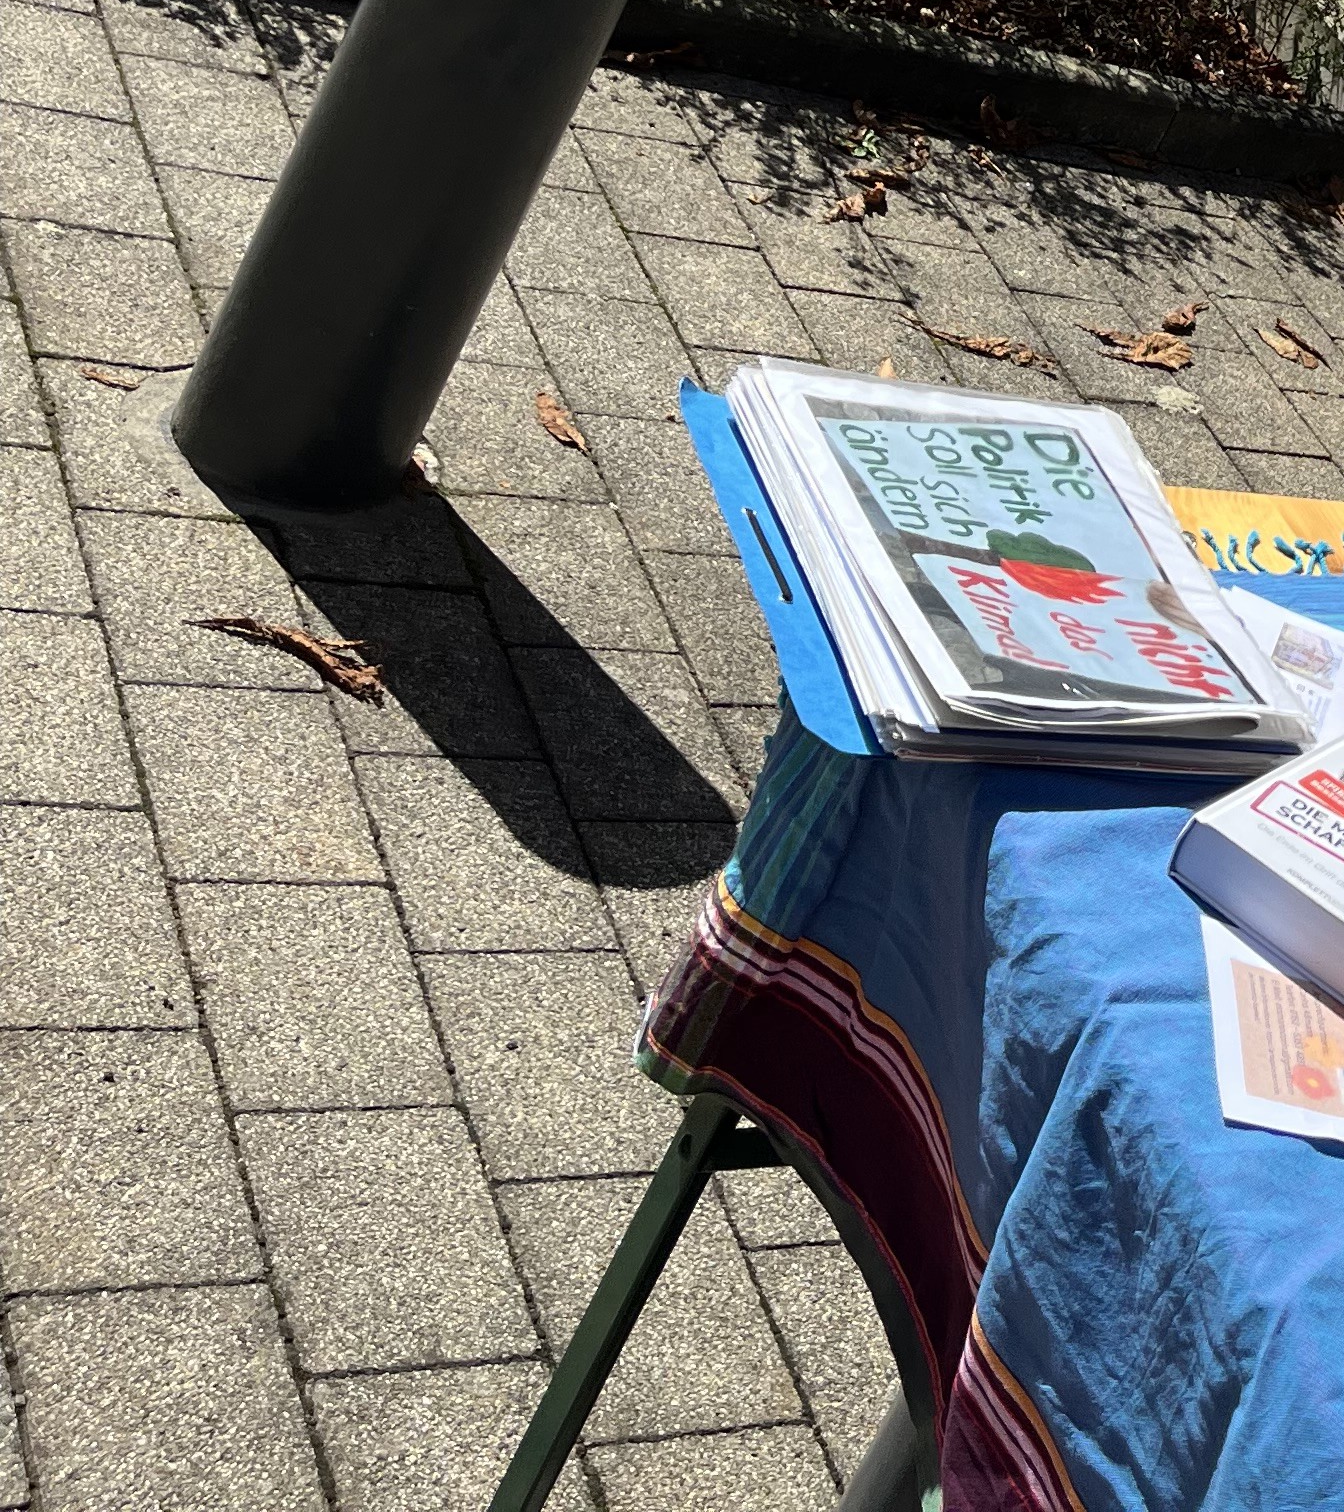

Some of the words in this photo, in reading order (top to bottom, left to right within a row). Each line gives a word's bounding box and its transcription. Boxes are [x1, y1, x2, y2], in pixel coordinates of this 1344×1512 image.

[838, 423, 930, 531] ändern
[906, 425, 978, 479] soll
[958, 427, 1054, 525] Politik
[1023, 430, 1095, 502] Die
[920, 475, 989, 538] sich
[1049, 611, 1115, 662] das
[1114, 617, 1234, 700] nicht
[1291, 798, 1330, 824] DIE
